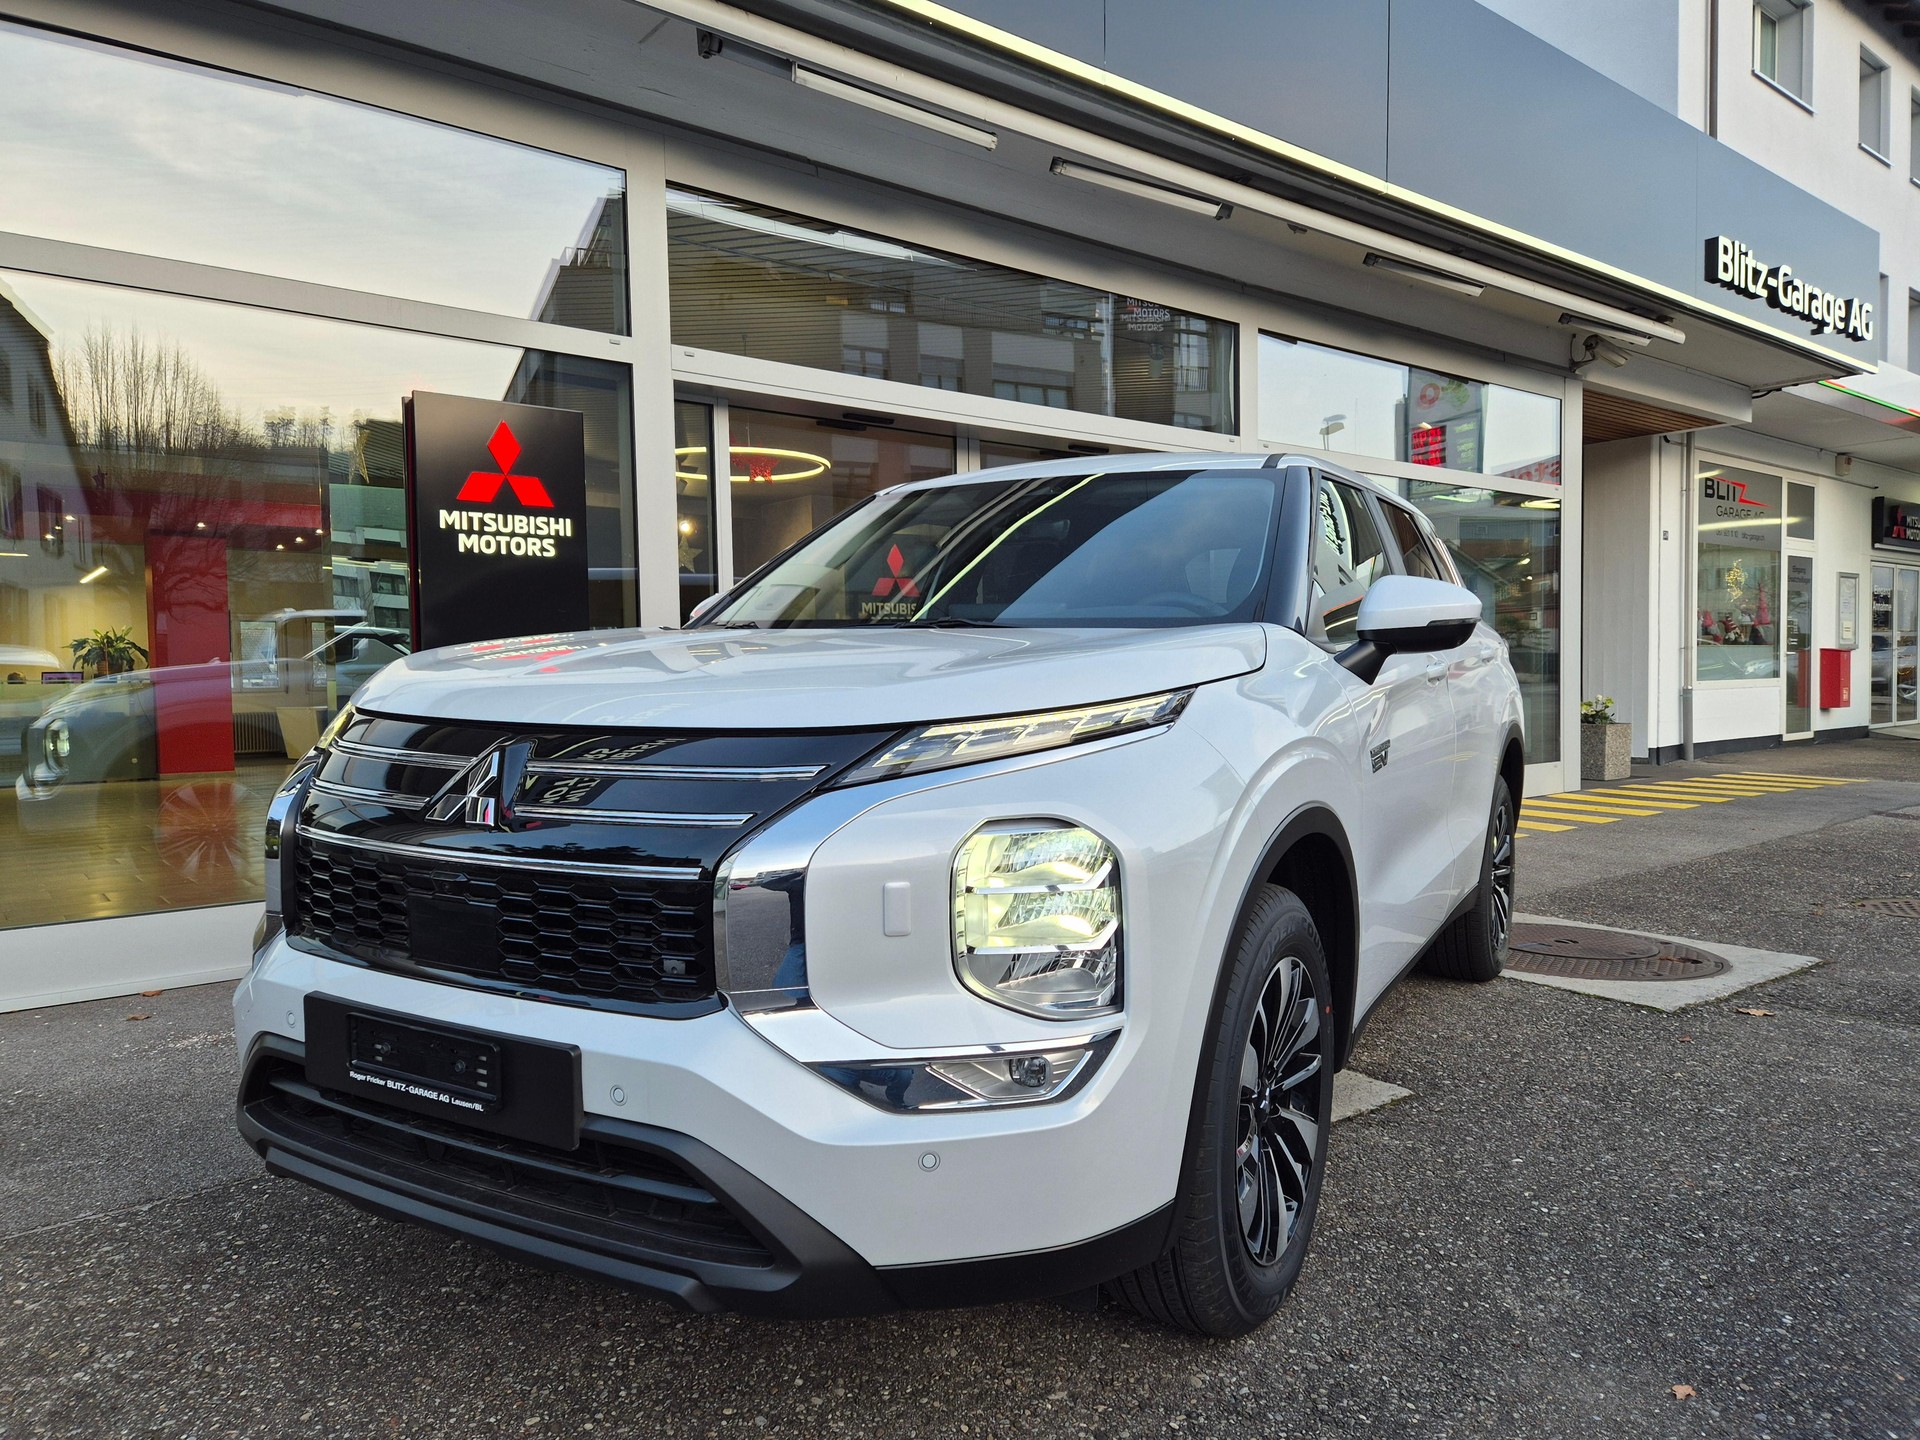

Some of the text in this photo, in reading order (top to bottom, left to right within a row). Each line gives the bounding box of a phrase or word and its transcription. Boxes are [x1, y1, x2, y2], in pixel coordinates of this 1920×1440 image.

[1717, 234, 1873, 341] Blitz-Garage AG
[439, 509, 572, 537] MITSUBISHI
[1716, 505, 1752, 519] GARAGE
[458, 533, 556, 558] MOTORS
[349, 1071, 367, 1082] Roger
[366, 1075, 386, 1087] Fricker
[386, 1080, 438, 1100] BLITZ-GARAGE
[439, 1093, 450, 1103] AG
